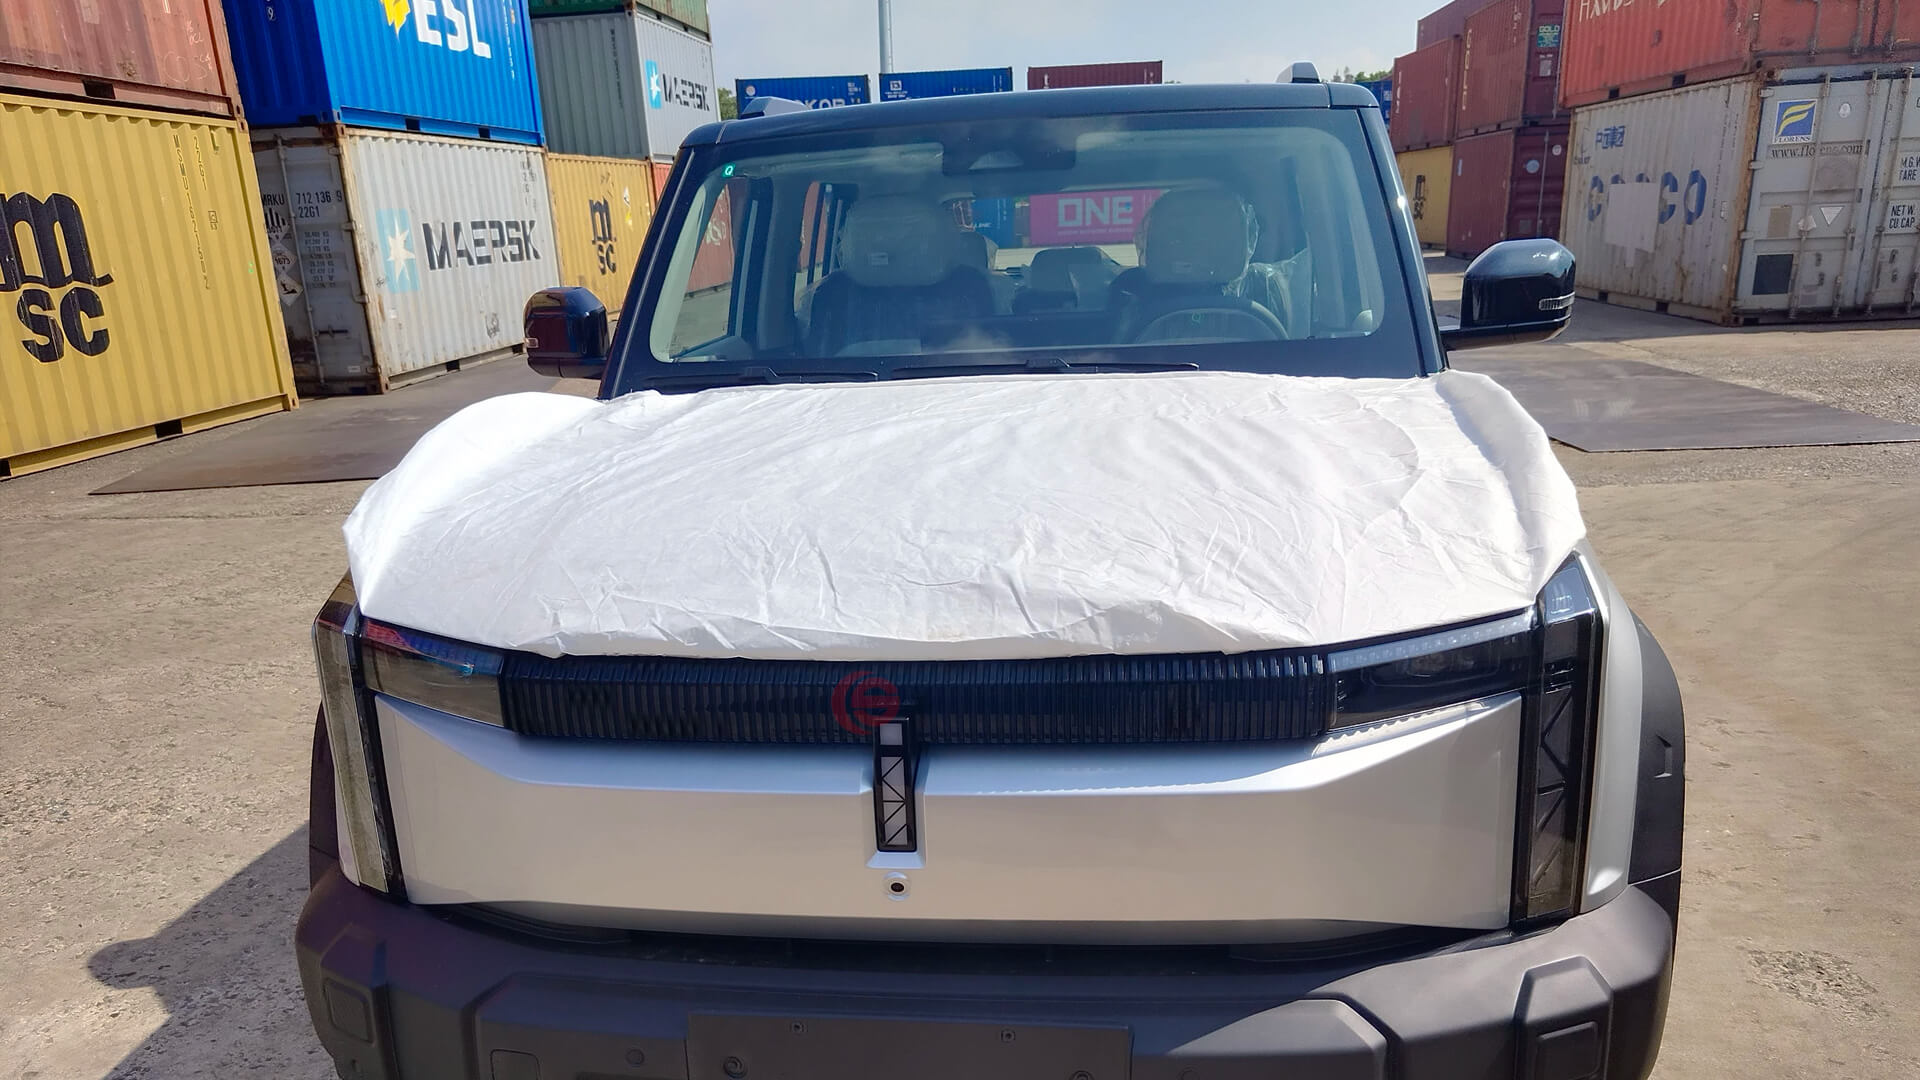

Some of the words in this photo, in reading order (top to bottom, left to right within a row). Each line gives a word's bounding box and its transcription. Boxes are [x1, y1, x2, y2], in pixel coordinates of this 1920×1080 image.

[413, 0, 492, 59] ESL
[662, 73, 710, 111] MAERSK
[296, 192, 312, 204] 712
[316, 191, 331, 203] 136
[299, 206, 320, 218] 22G1
[1058, 196, 1134, 227] ONE
[1891, 205, 1905, 216] NET
[422, 220, 541, 271] MAERSK
